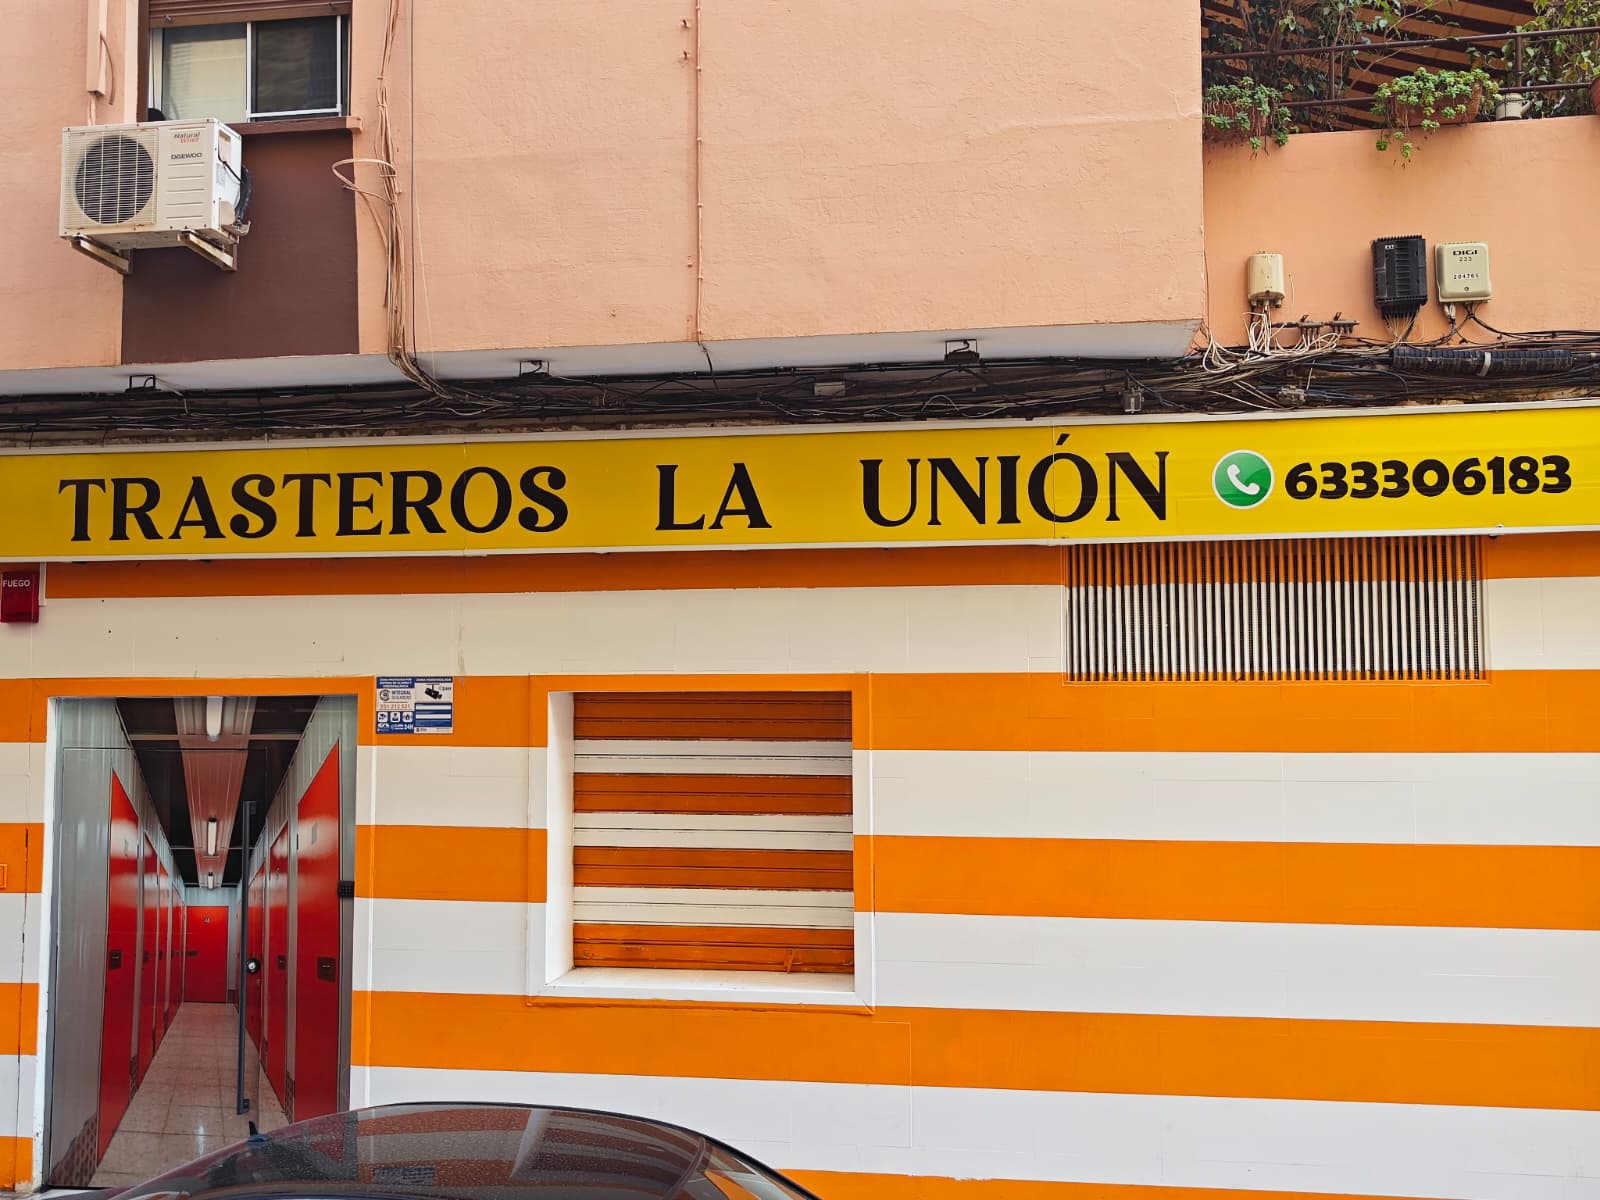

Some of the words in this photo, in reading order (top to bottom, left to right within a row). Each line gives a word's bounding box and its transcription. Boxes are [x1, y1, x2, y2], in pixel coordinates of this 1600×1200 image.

[58, 466, 568, 541] TRASTEROS
[656, 463, 772, 530] LA
[860, 434, 1169, 527] UNIÓN
[1285, 455, 1571, 499] 633306183
[2, 579, 31, 588] FUEGO
